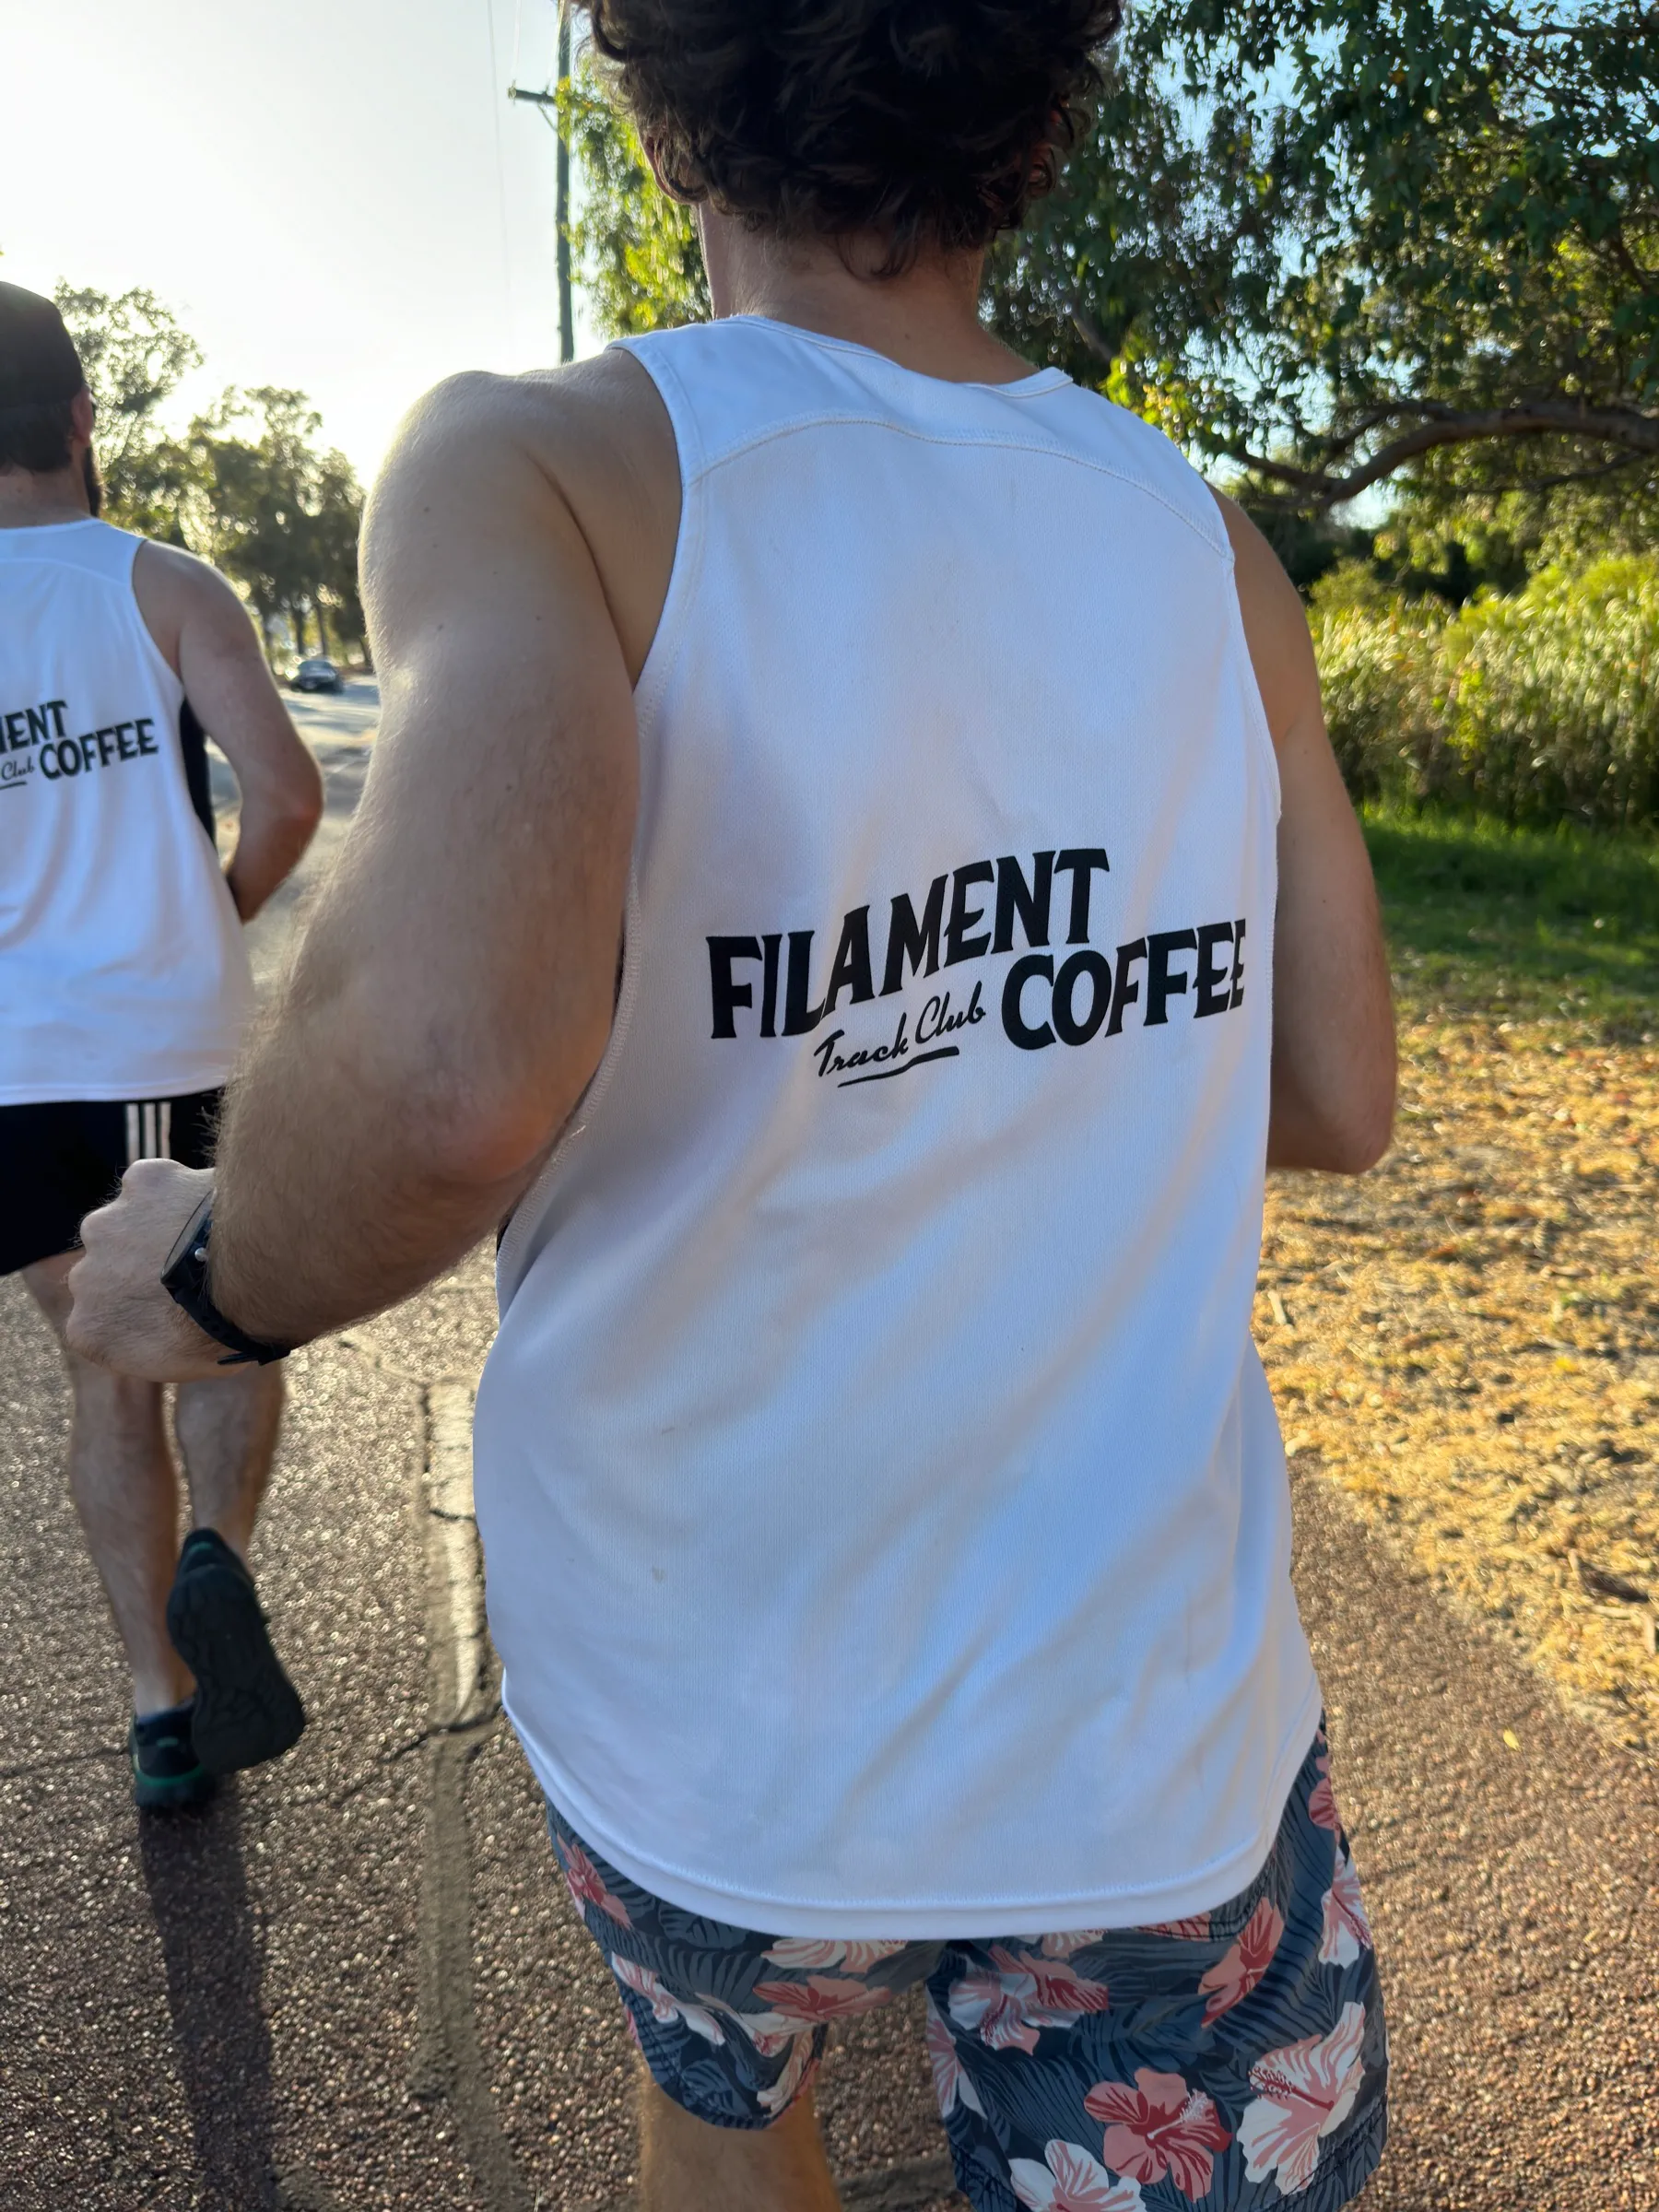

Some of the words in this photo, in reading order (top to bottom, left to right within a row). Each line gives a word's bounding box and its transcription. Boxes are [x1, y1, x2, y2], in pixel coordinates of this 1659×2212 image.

[0, 700, 68, 754] ENT
[40, 717, 159, 780] COFFEE
[1, 756, 35, 781] Club
[706, 848, 1110, 1039] FILAMENT
[1002, 918, 1246, 1050] COFFEE
[814, 1012, 910, 1077] Track
[914, 982, 986, 1042] Club
